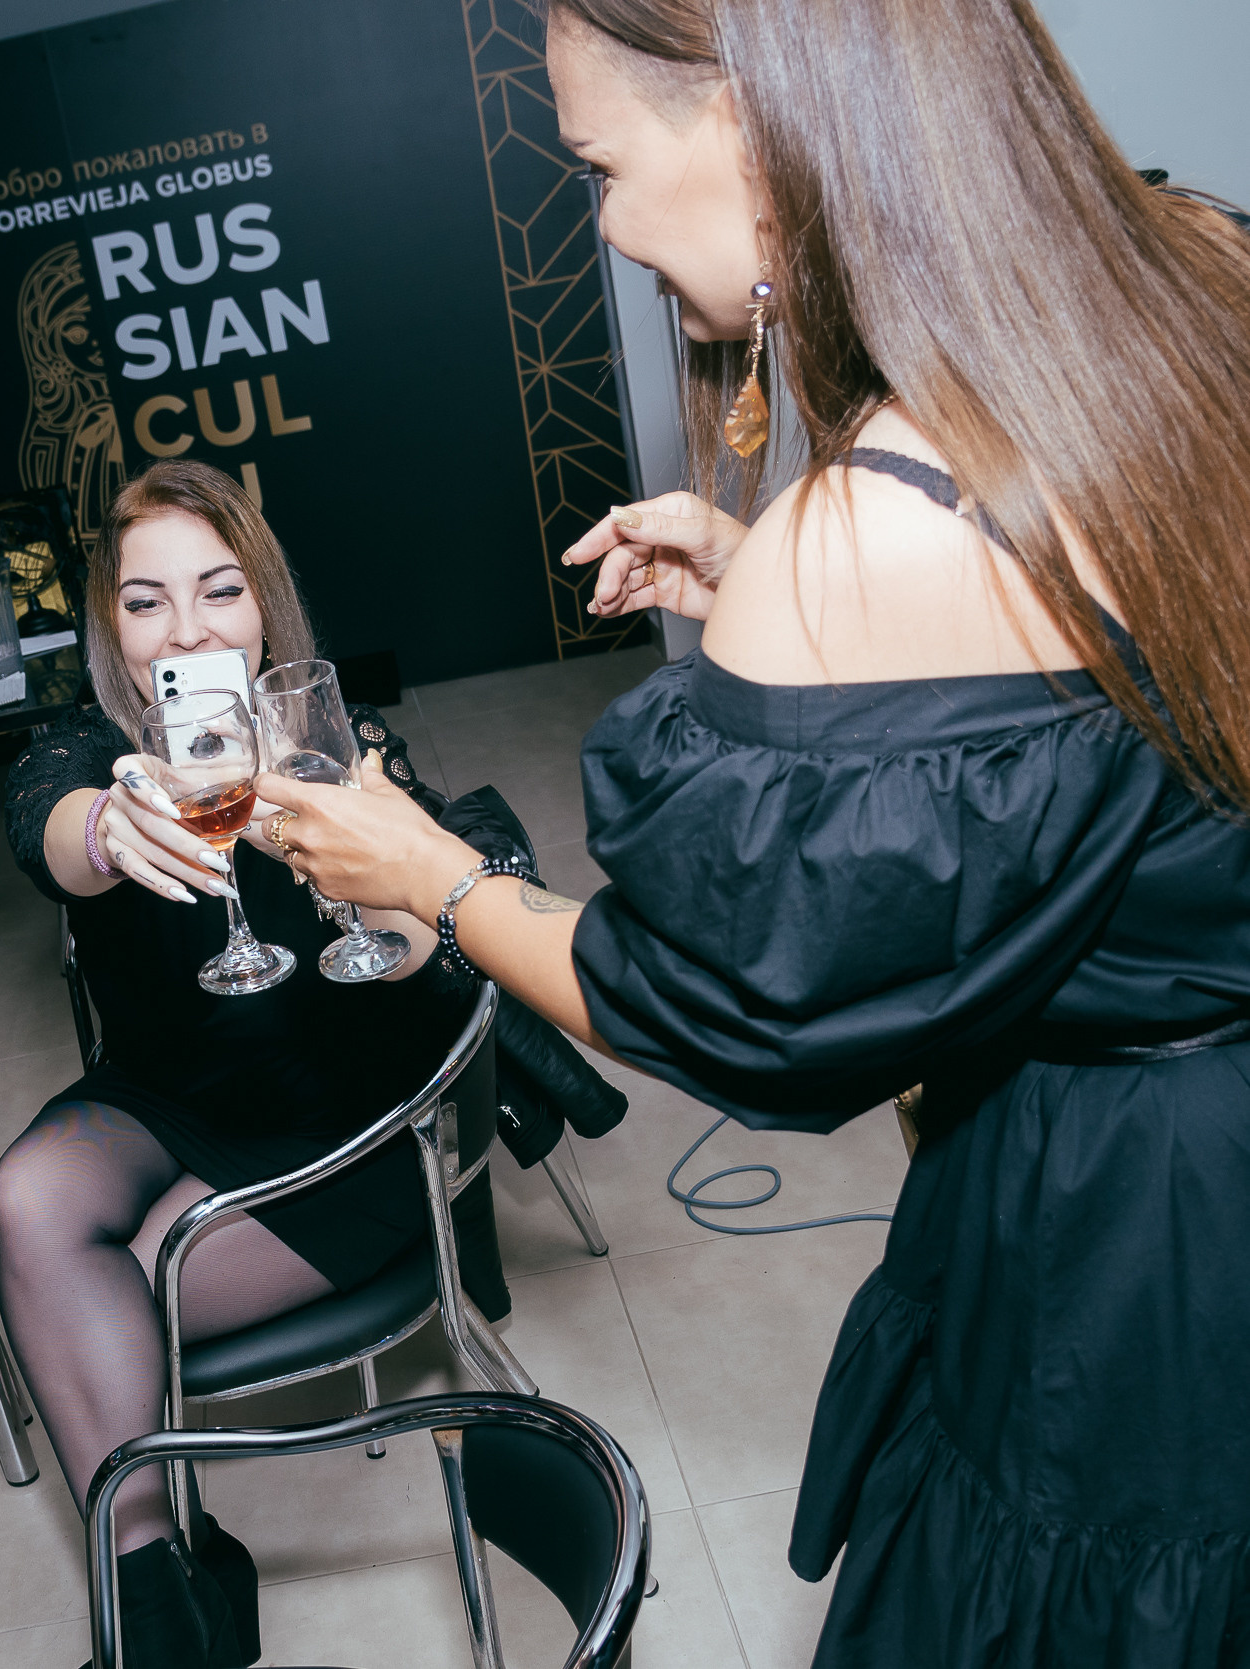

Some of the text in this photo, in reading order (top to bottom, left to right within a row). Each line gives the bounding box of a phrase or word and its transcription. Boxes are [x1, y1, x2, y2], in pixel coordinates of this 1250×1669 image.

[72, 126, 245, 183] пожаловать
[251, 123, 269, 144] в
[155, 154, 273, 199] GLOBUS
[91, 202, 281, 301] RUS
[114, 279, 331, 381] SIAN
[133, 373, 314, 458] CUL
